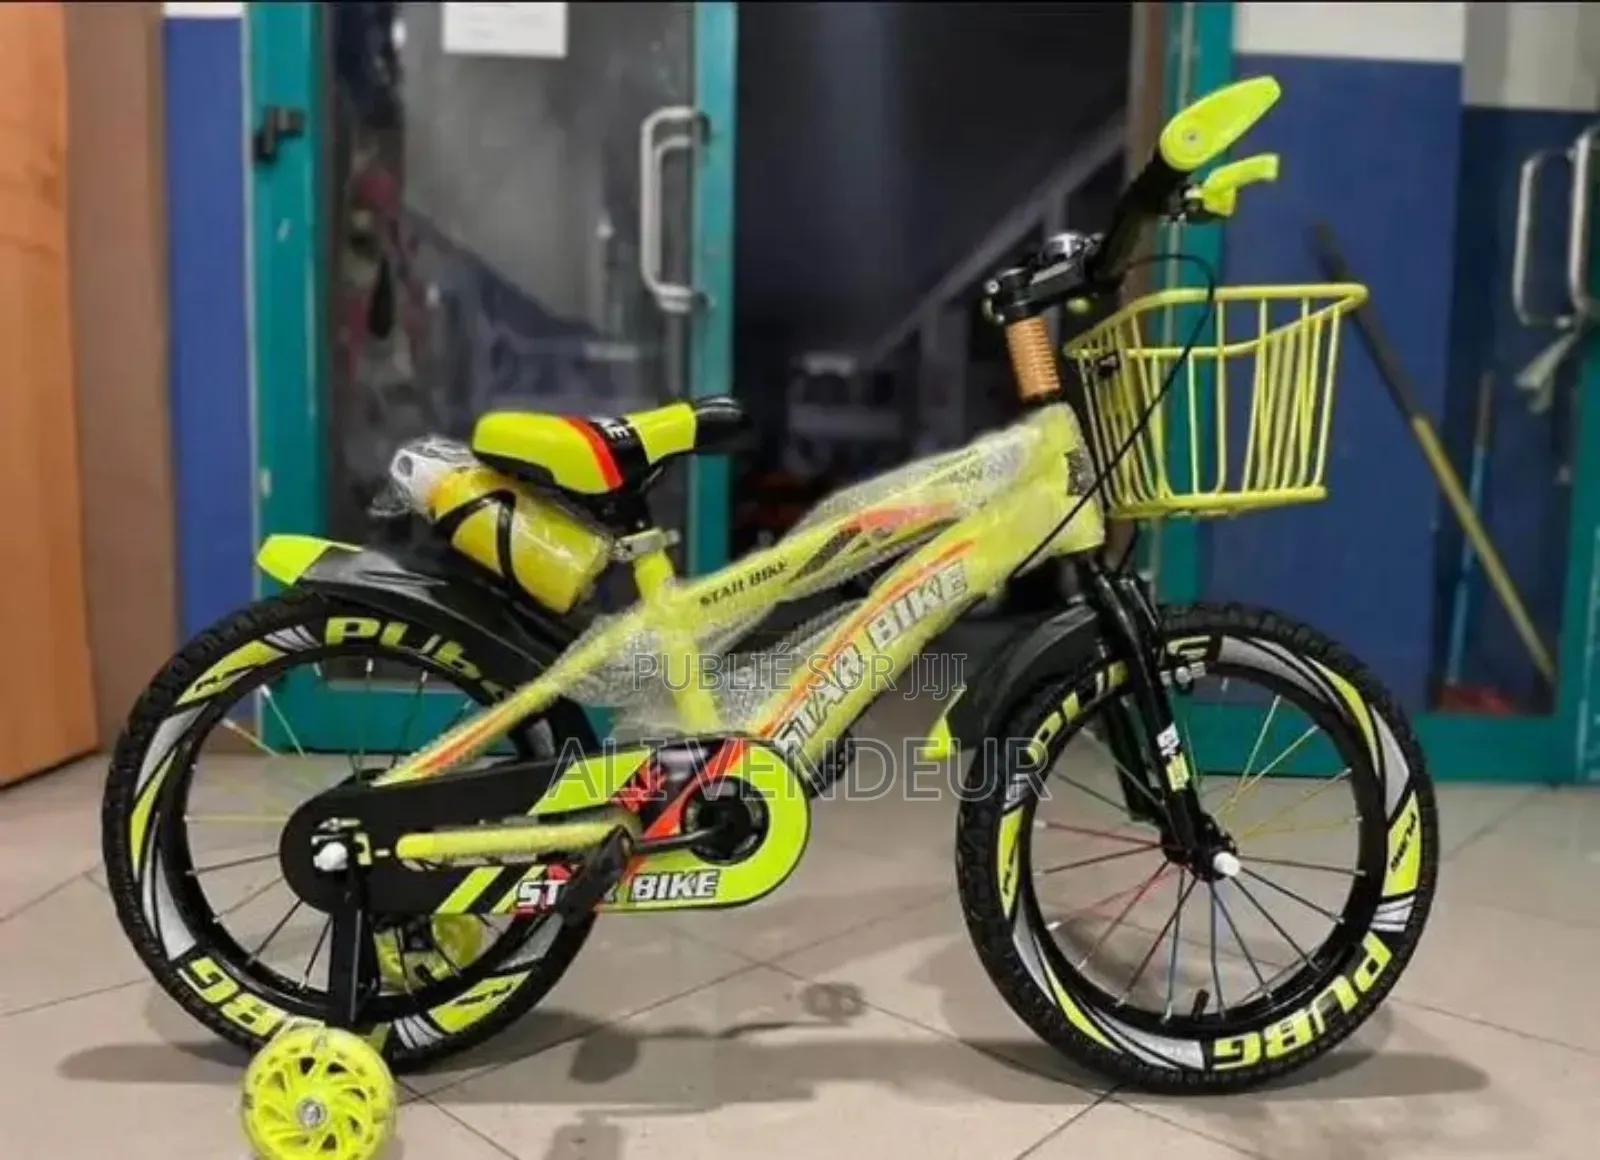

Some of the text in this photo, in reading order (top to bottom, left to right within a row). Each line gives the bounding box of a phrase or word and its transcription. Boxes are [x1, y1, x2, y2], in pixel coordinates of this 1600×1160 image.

[866, 560, 969, 653] BIKE
[633, 870, 720, 900] BIKE
[1212, 930, 1393, 1071] PUBG
